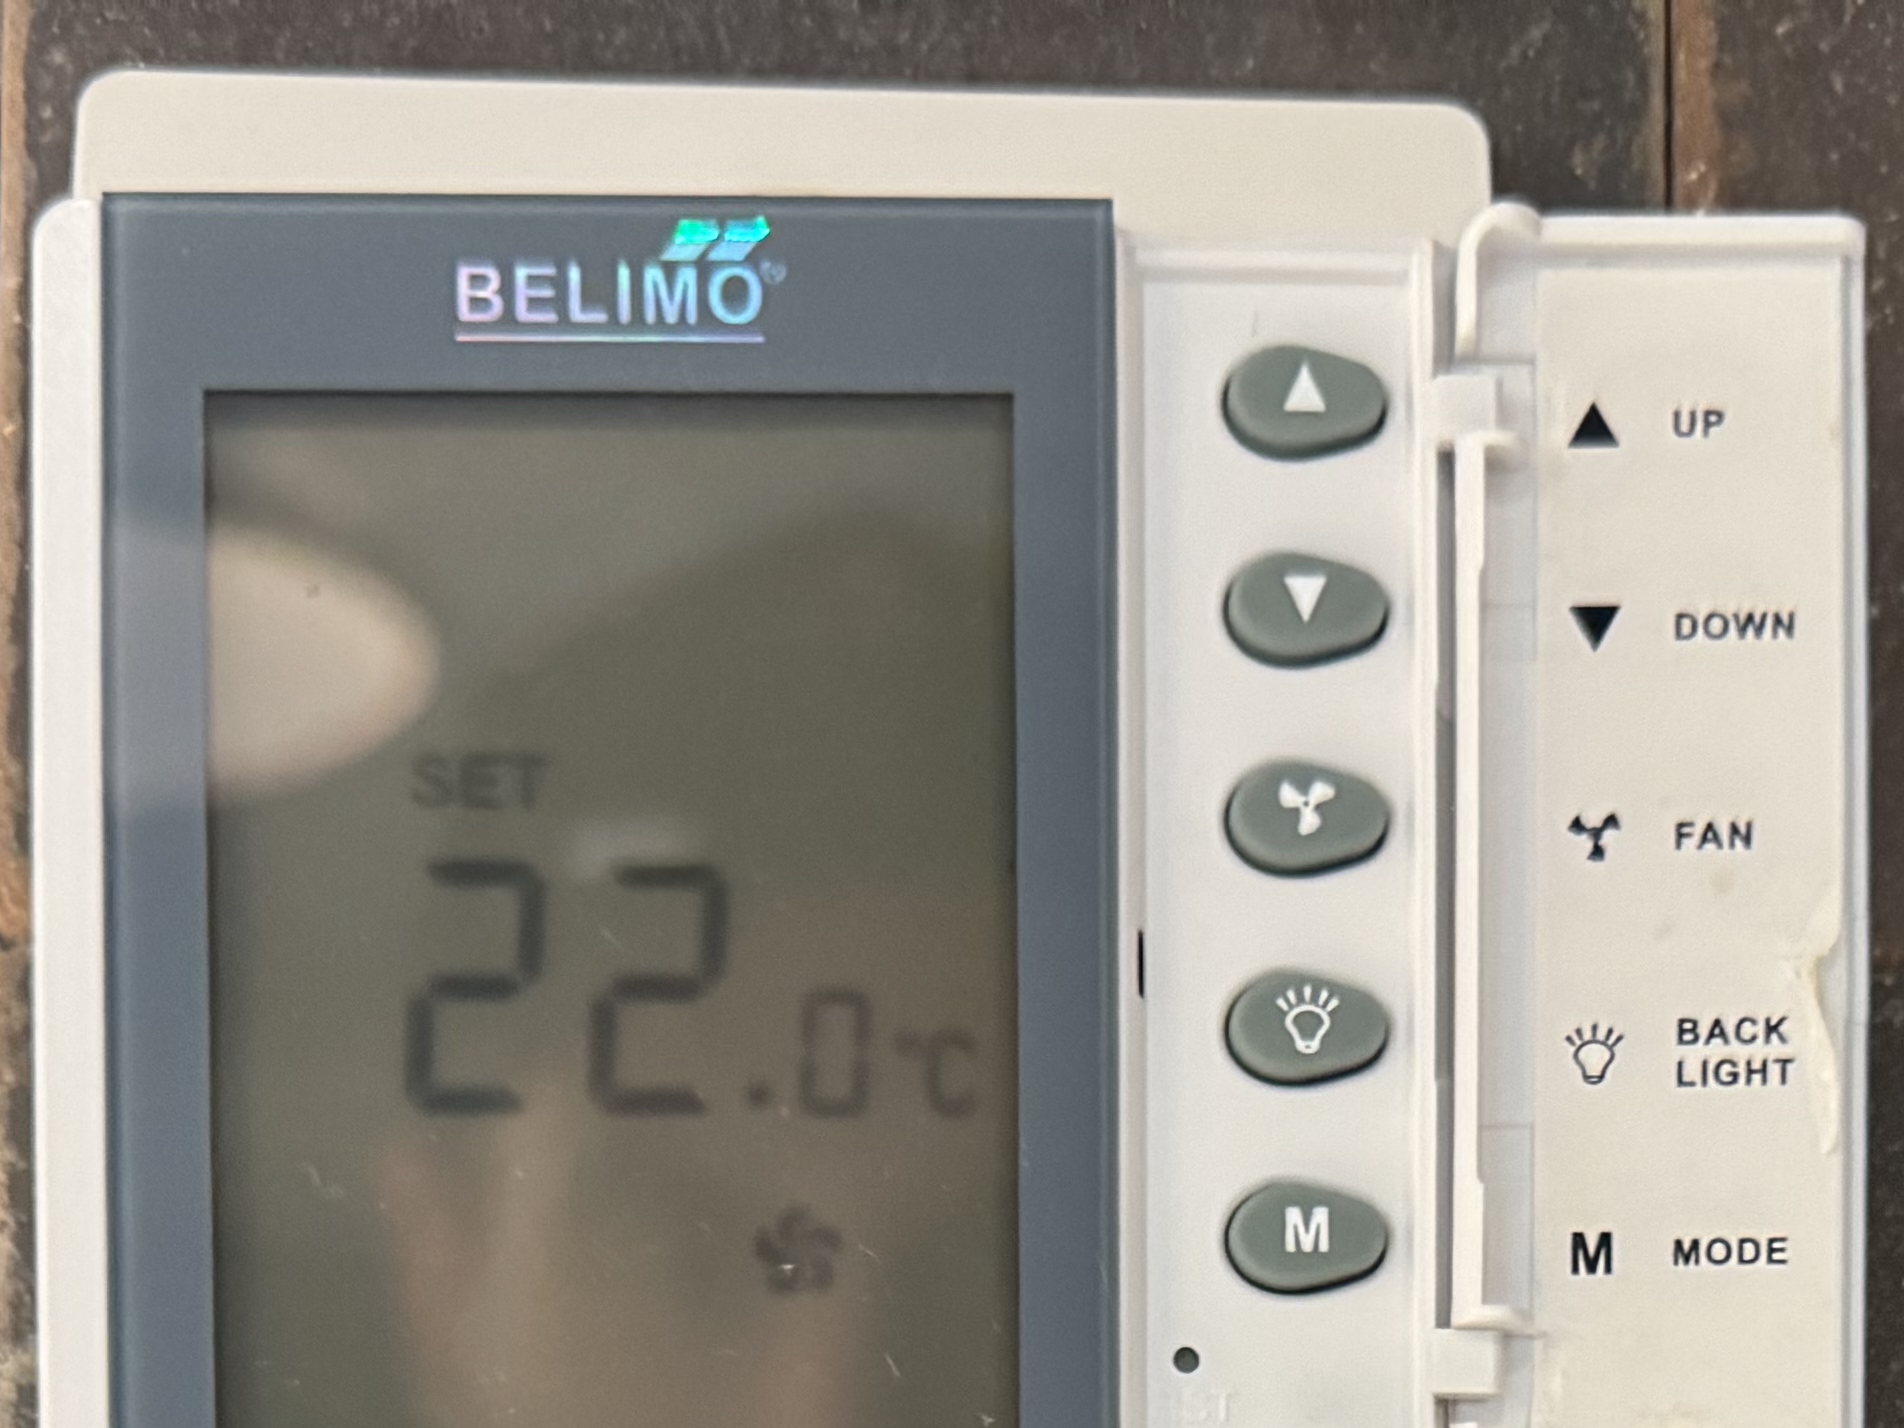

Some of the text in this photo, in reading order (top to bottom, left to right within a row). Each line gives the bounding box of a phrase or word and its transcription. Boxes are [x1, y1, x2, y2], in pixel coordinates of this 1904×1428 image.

[1672, 409, 1726, 439] UP
[1673, 611, 1797, 642] DOWN
[411, 752, 549, 811] SET
[1673, 821, 1755, 851] FAN
[1675, 1016, 1790, 1046] BACK
[1675, 1058, 1796, 1088] LIGHT
[1283, 1207, 1330, 1254] M
[1569, 1231, 1790, 1276] M MODE
